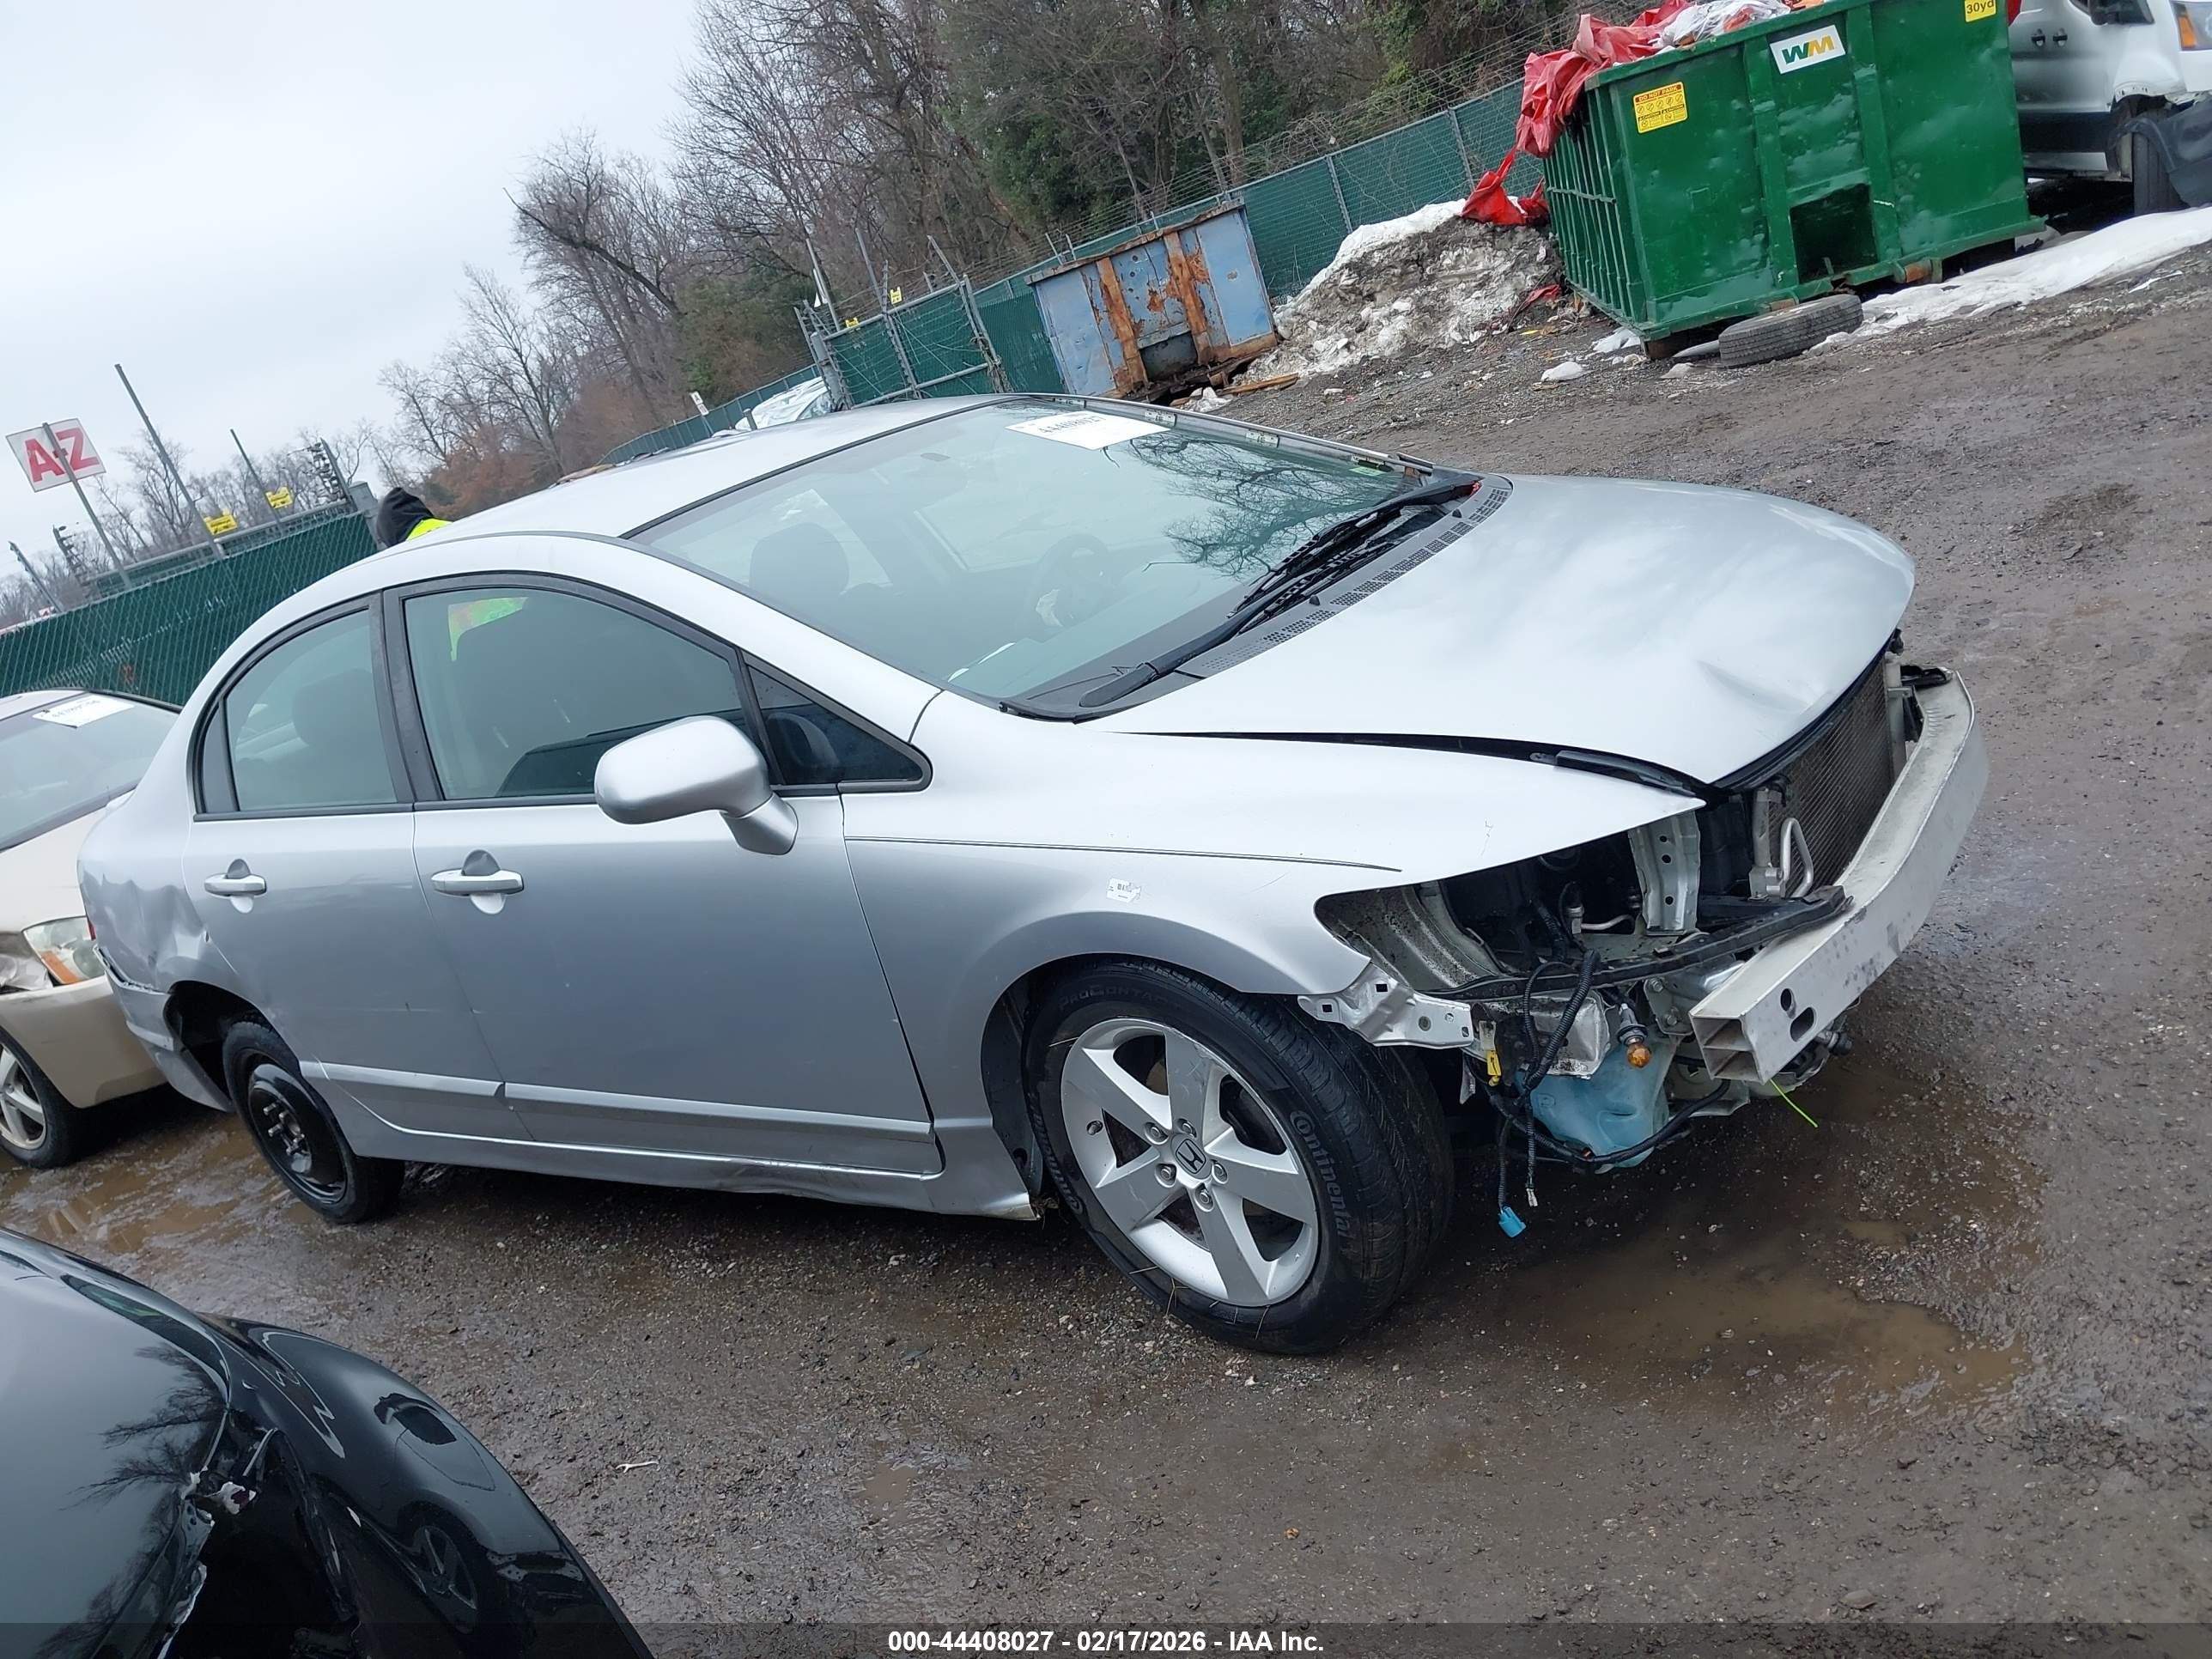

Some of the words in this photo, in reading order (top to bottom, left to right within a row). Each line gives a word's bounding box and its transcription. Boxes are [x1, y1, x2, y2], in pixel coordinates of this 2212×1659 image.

[1966, 0, 1994, 14] 30yd
[1782, 35, 1834, 64] WM
[1290, 1109, 1354, 1237] Continental
